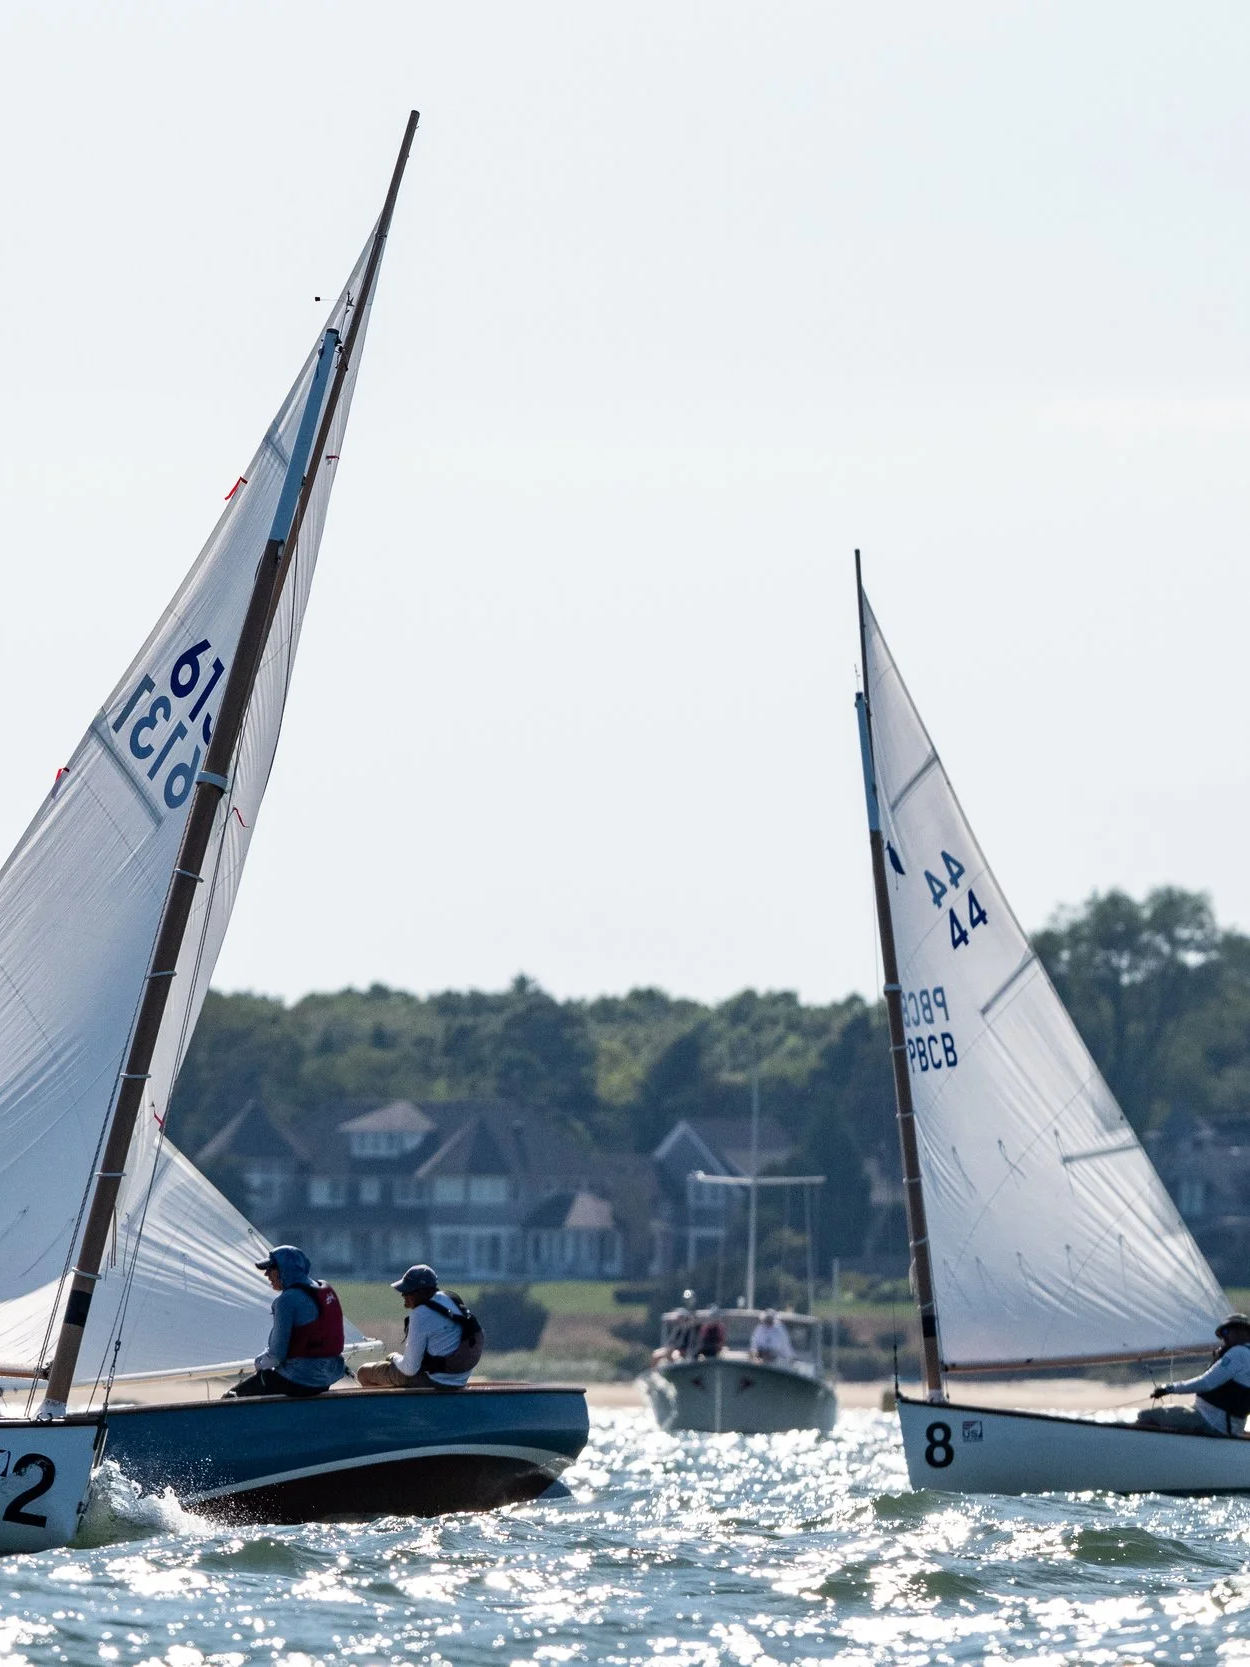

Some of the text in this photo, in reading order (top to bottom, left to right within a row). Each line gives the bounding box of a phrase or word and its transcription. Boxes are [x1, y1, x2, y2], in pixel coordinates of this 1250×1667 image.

[948, 888, 988, 950] 44
[907, 1032, 958, 1074] PBCB
[925, 1421, 955, 1468] 8
[2, 1453, 56, 1528] 2
